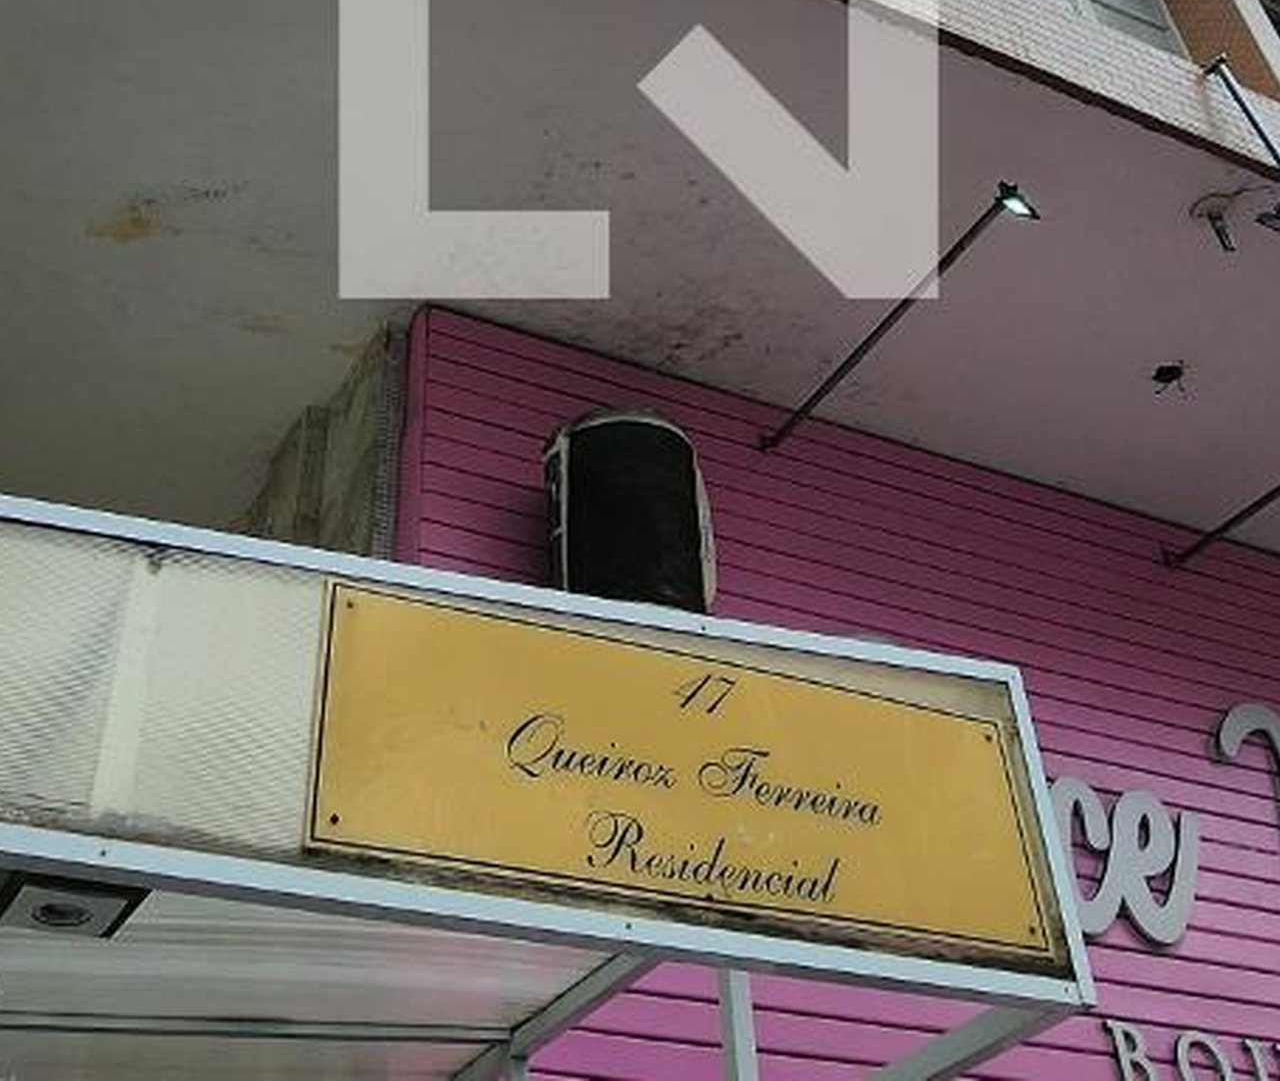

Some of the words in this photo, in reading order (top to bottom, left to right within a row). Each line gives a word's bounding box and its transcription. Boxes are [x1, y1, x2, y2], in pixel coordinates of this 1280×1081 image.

[673, 674, 736, 715] 47
[505, 712, 678, 789] Queiroz
[698, 747, 883, 827] Ferreira
[587, 809, 840, 903] Residencial
[1048, 777, 1199, 944] ce
